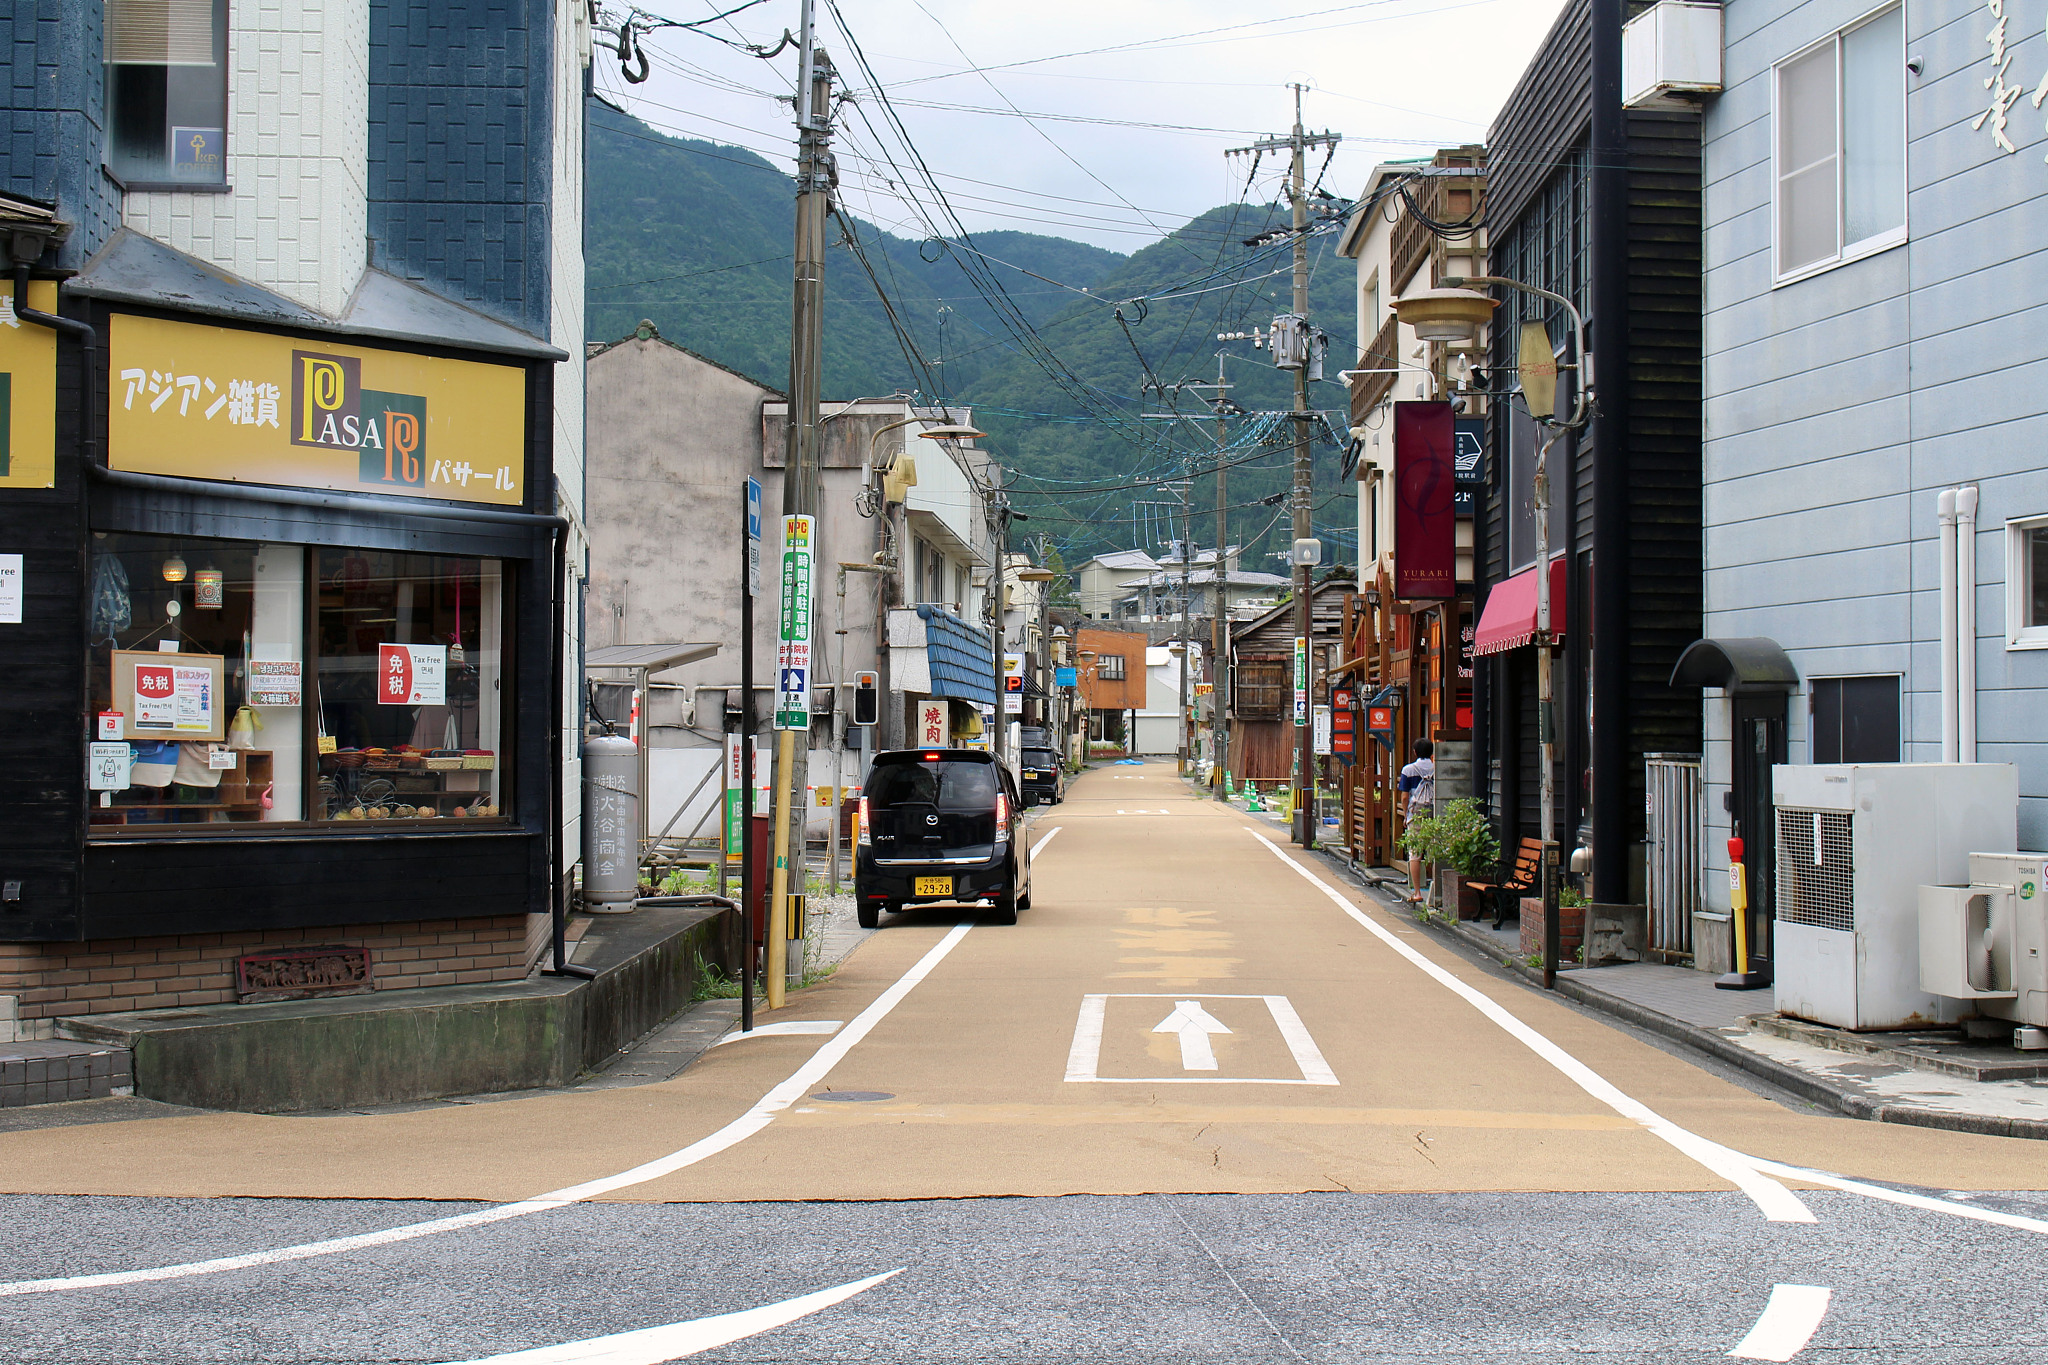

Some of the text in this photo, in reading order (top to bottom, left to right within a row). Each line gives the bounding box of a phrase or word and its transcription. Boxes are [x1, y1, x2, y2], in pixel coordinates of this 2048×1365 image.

[200, 153, 221, 163] KEY
[120, 367, 281, 430] アジアン雑貨
[299, 356, 419, 483] PASAR
[430, 459, 516, 492] パサール
[788, 521, 807, 533] NPC
[1403, 569, 1448, 577] YURARI
[795, 554, 809, 639] 時間貸駐車場
[414, 655, 442, 665] Tax Free
[389, 654, 405, 696] 免税
[142, 675, 169, 690] 免税
[1008, 677, 1021, 691] P
[924, 707, 942, 744] 焼肉
[2018, 867, 2036, 875] TOSHIBA
[923, 884, 950, 894] 29-28
